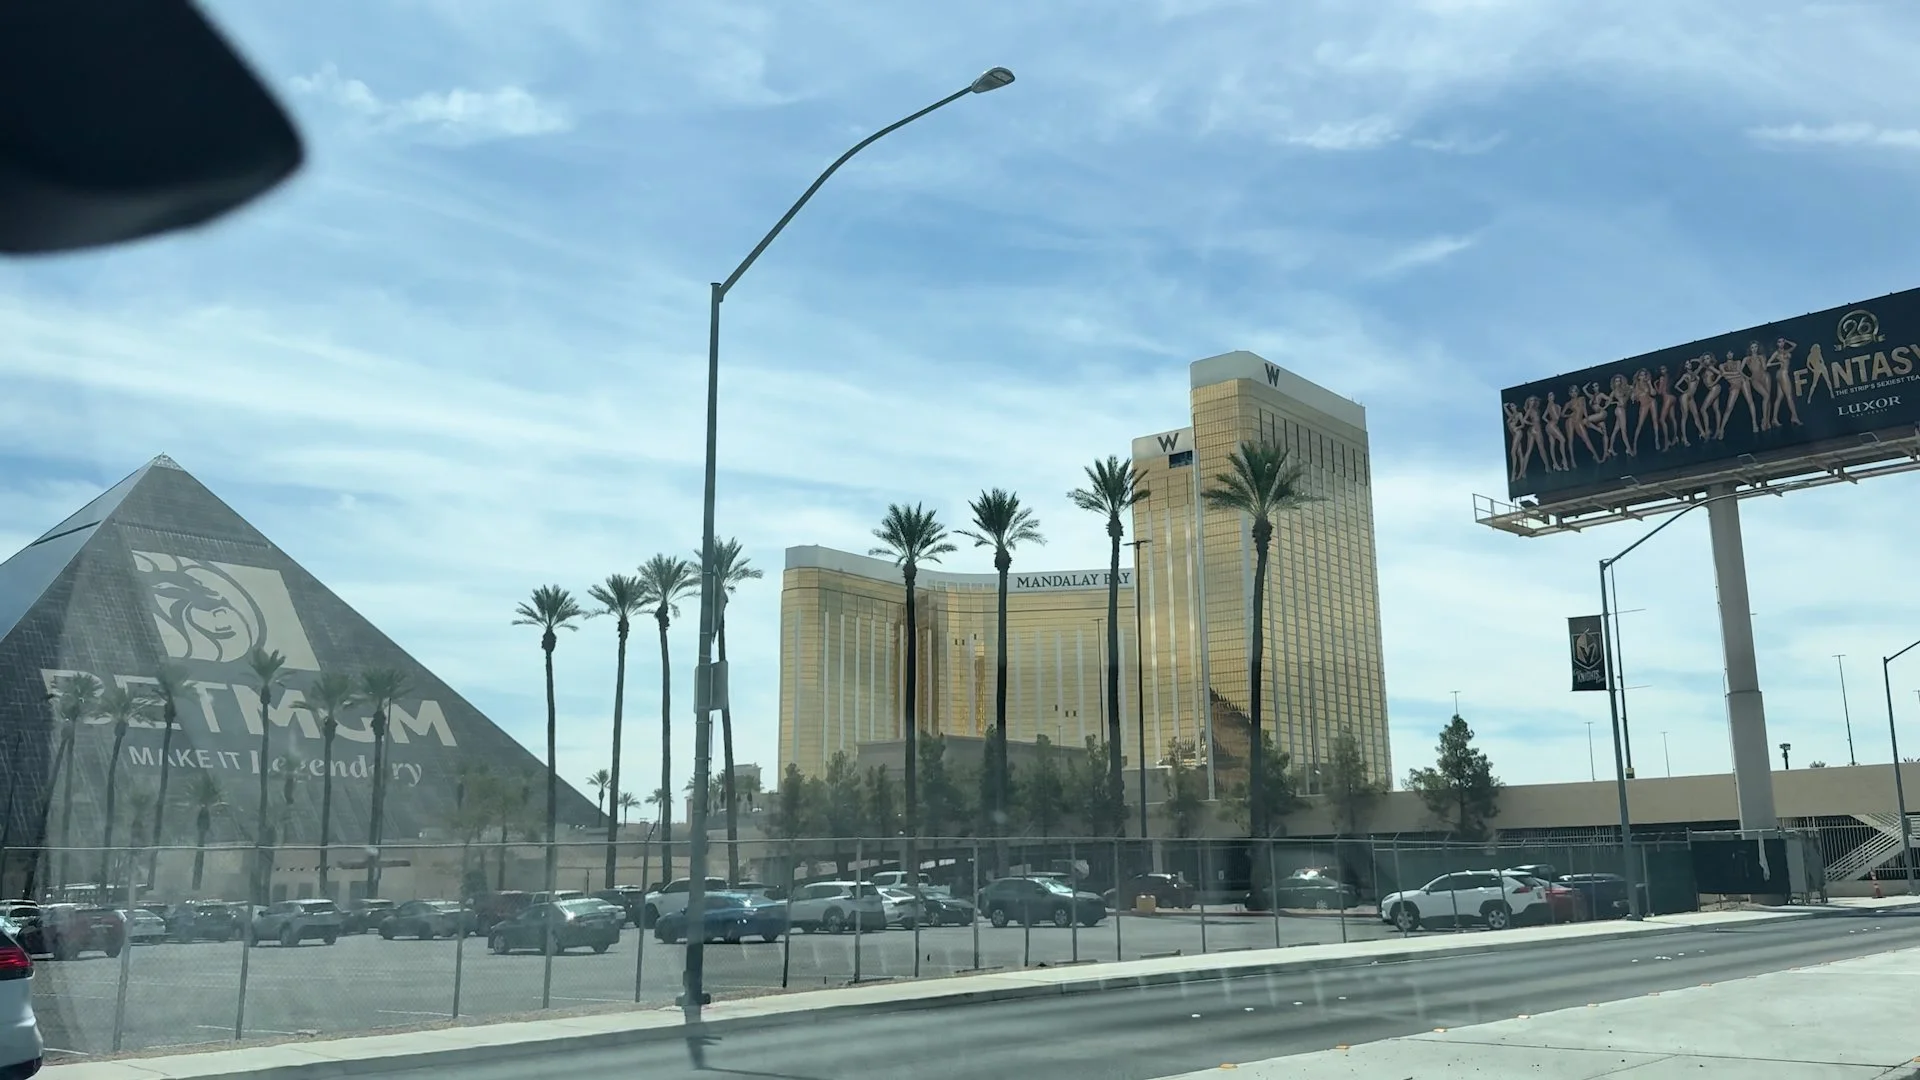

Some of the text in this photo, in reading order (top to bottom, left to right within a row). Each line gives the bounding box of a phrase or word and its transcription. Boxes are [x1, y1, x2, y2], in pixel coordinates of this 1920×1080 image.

[1842, 316, 1872, 339] 26
[1264, 362, 1280, 387] W
[1835, 388, 1849, 397] THE
[1850, 383, 1876, 394] STRIP'S
[1876, 376, 1905, 388] SEXIEST
[1837, 396, 1902, 416] LUXOR
[1157, 432, 1180, 453] W
[1017, 573, 1099, 588] MANDALAY
[128, 745, 214, 769] MAKE
[217, 750, 241, 770] IT
